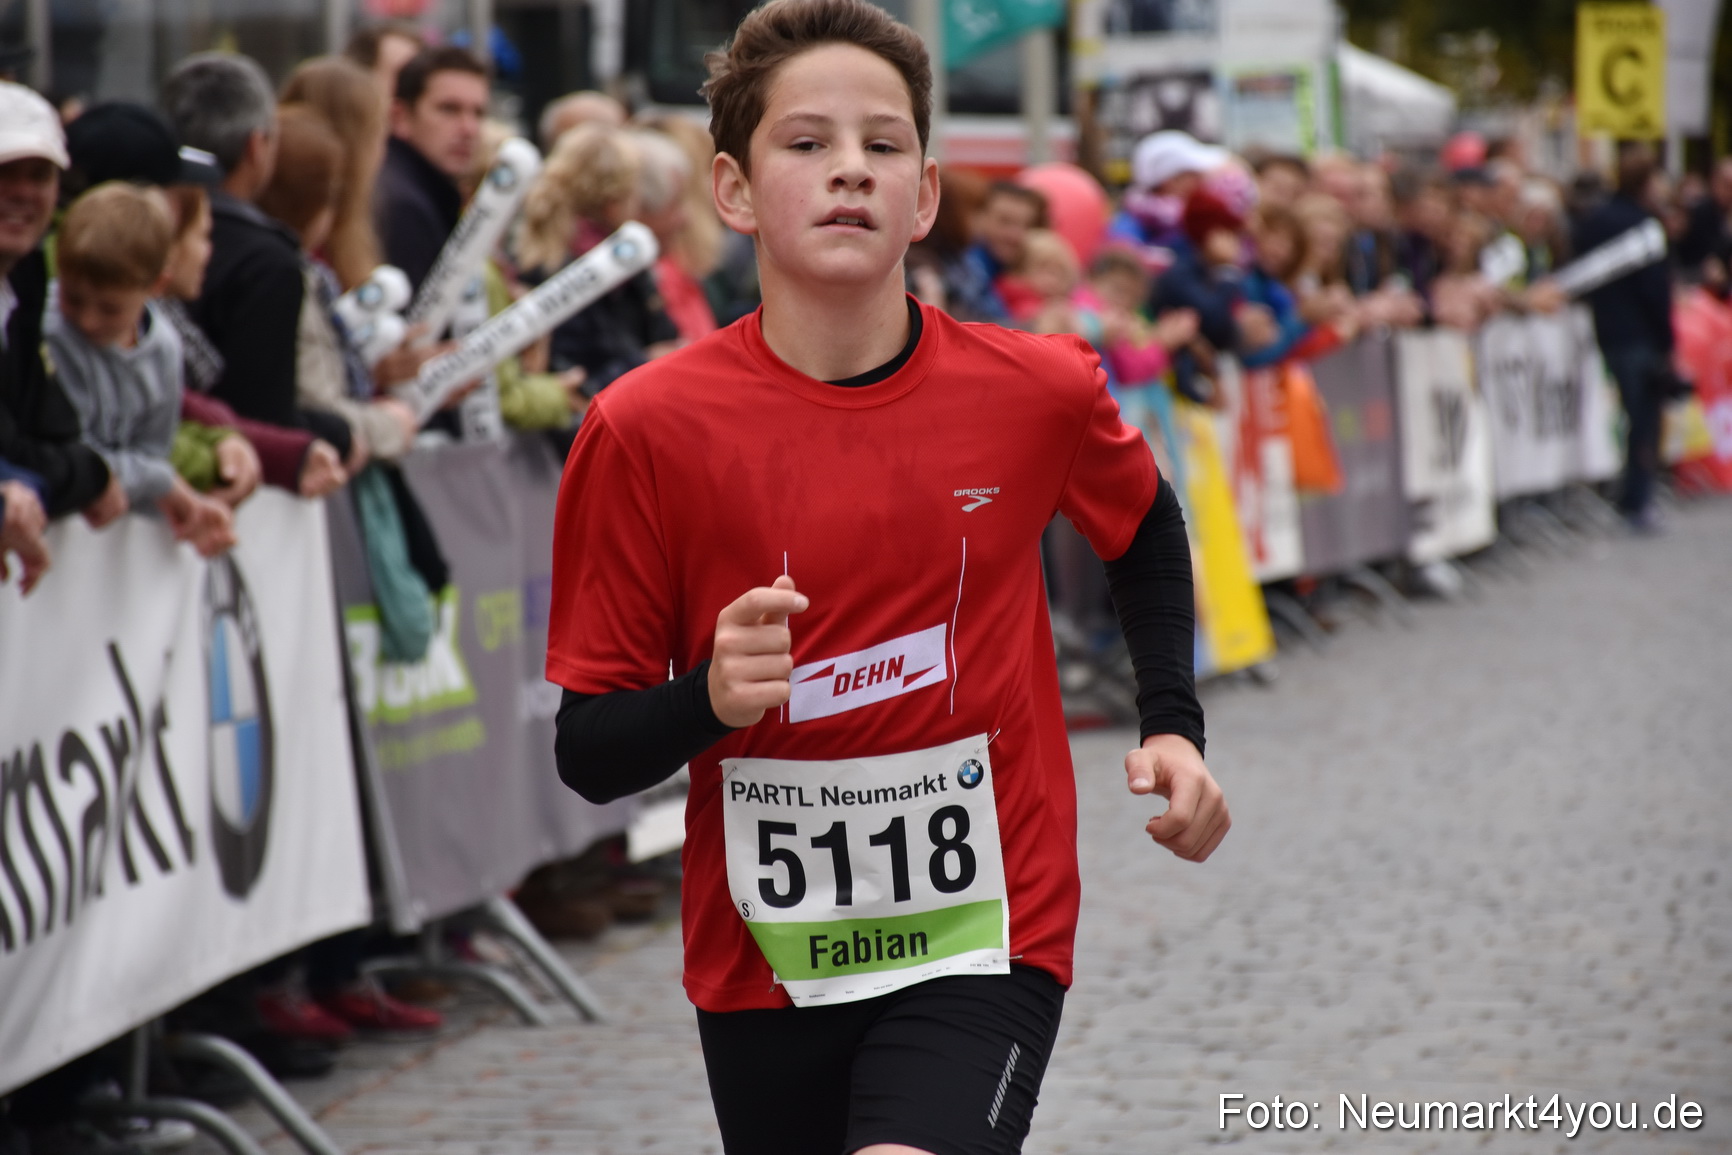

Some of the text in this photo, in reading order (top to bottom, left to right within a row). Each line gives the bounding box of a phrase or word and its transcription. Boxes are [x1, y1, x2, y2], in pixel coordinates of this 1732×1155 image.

[954, 487, 1000, 497] BROOKS
[832, 654, 904, 697] DEHN
[0, 640, 195, 953] markt
[730, 773, 948, 807] PARTL Neumarkt
[758, 805, 977, 909] 5118
[741, 903, 750, 917] S
[809, 929, 928, 969] Fabian
